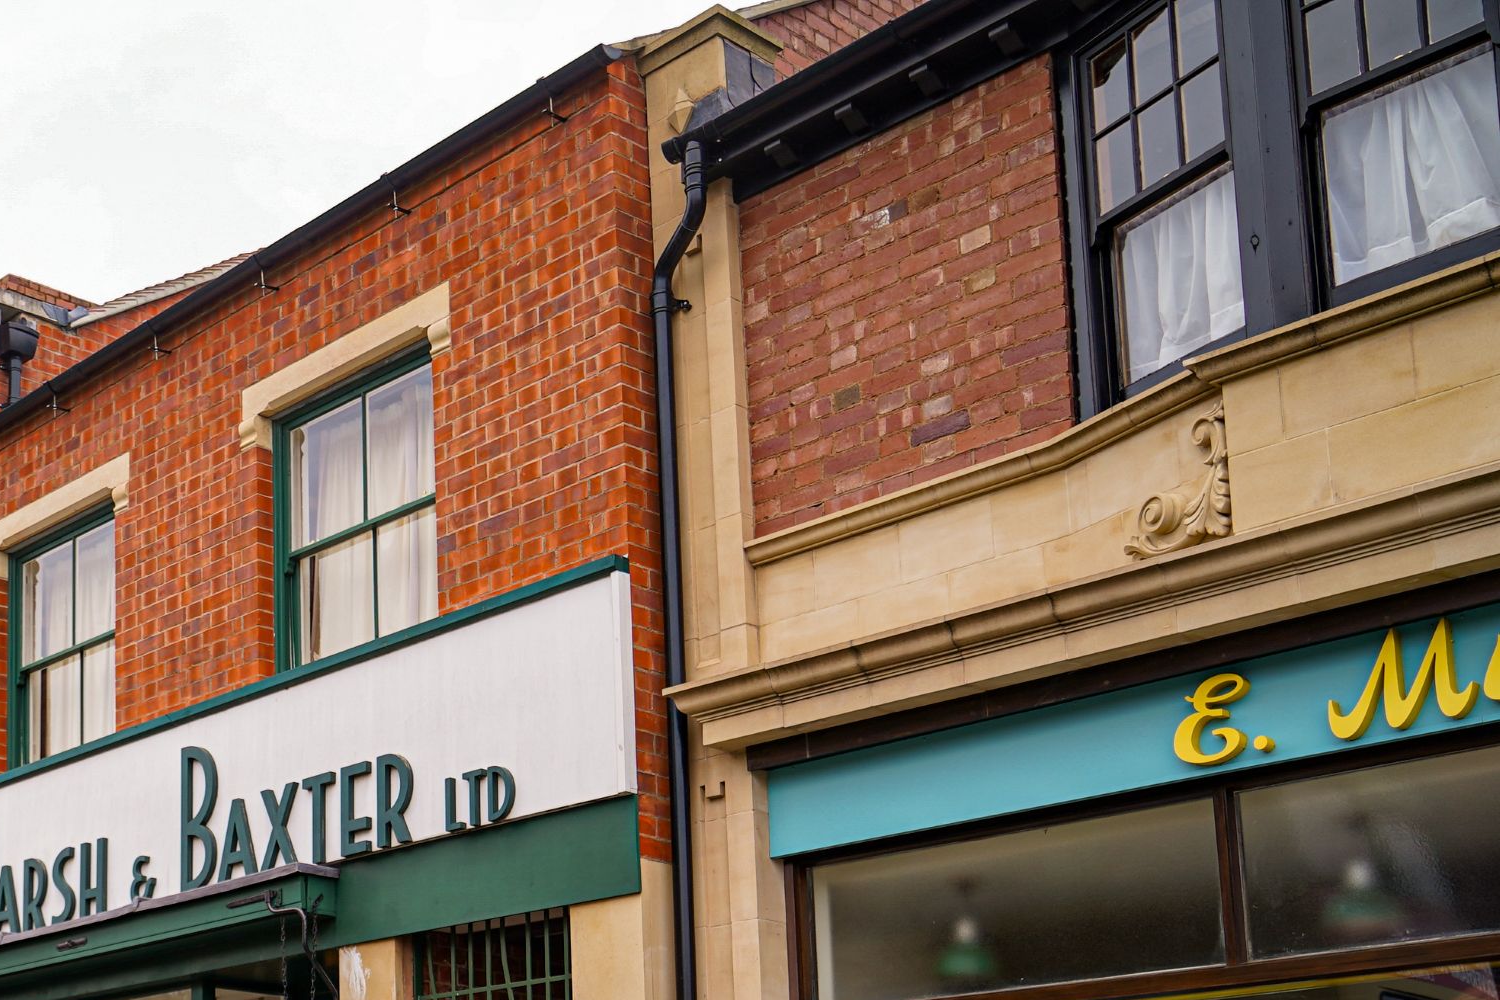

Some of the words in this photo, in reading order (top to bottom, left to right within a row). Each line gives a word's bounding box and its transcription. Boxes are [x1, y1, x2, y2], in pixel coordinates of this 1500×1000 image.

[1327, 616, 1500, 742] M
[130, 855, 157, 902] &
[180, 745, 414, 893] BAXTER
[444, 765, 516, 833] LTD
